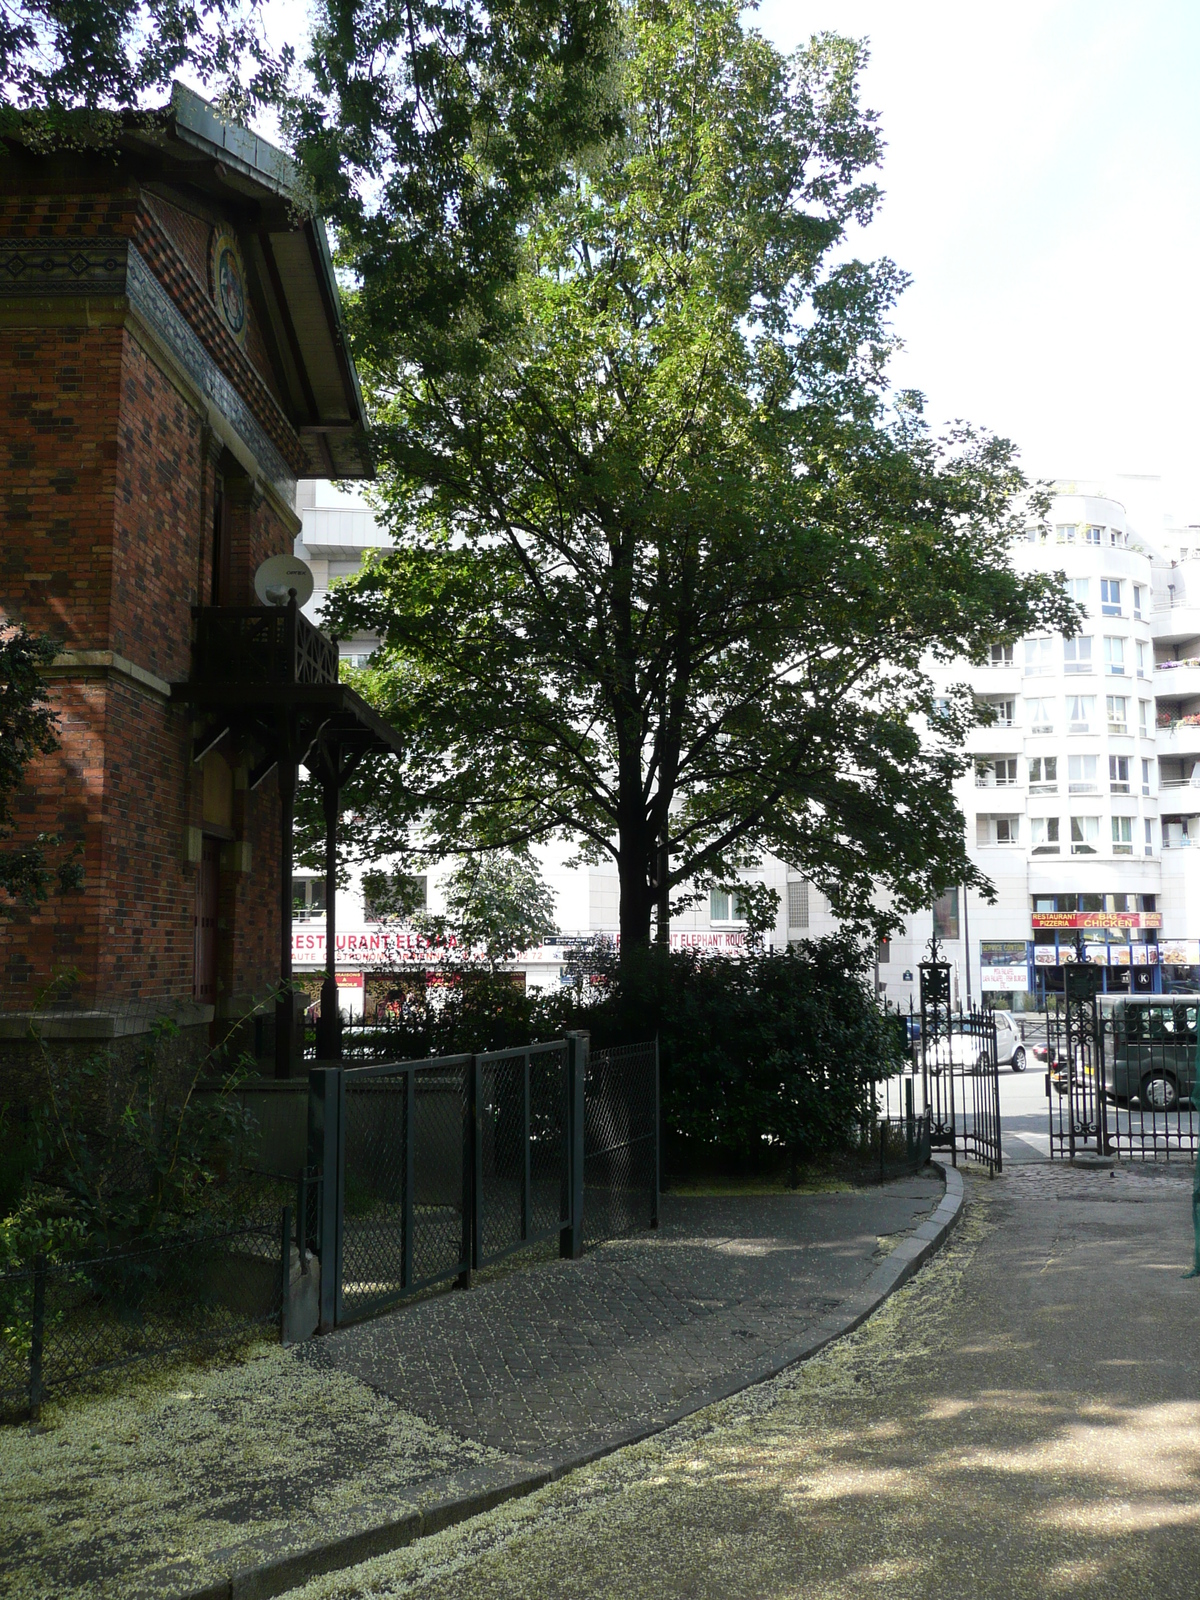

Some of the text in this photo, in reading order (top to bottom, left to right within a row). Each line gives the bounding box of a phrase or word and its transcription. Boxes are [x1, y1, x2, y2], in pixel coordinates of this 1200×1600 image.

[1083, 919, 1133, 927] CHICKEN
[681, 934, 723, 947] ELEPHANT
[291, 953, 317, 961] AUTE
[1141, 974, 1148, 983] K
